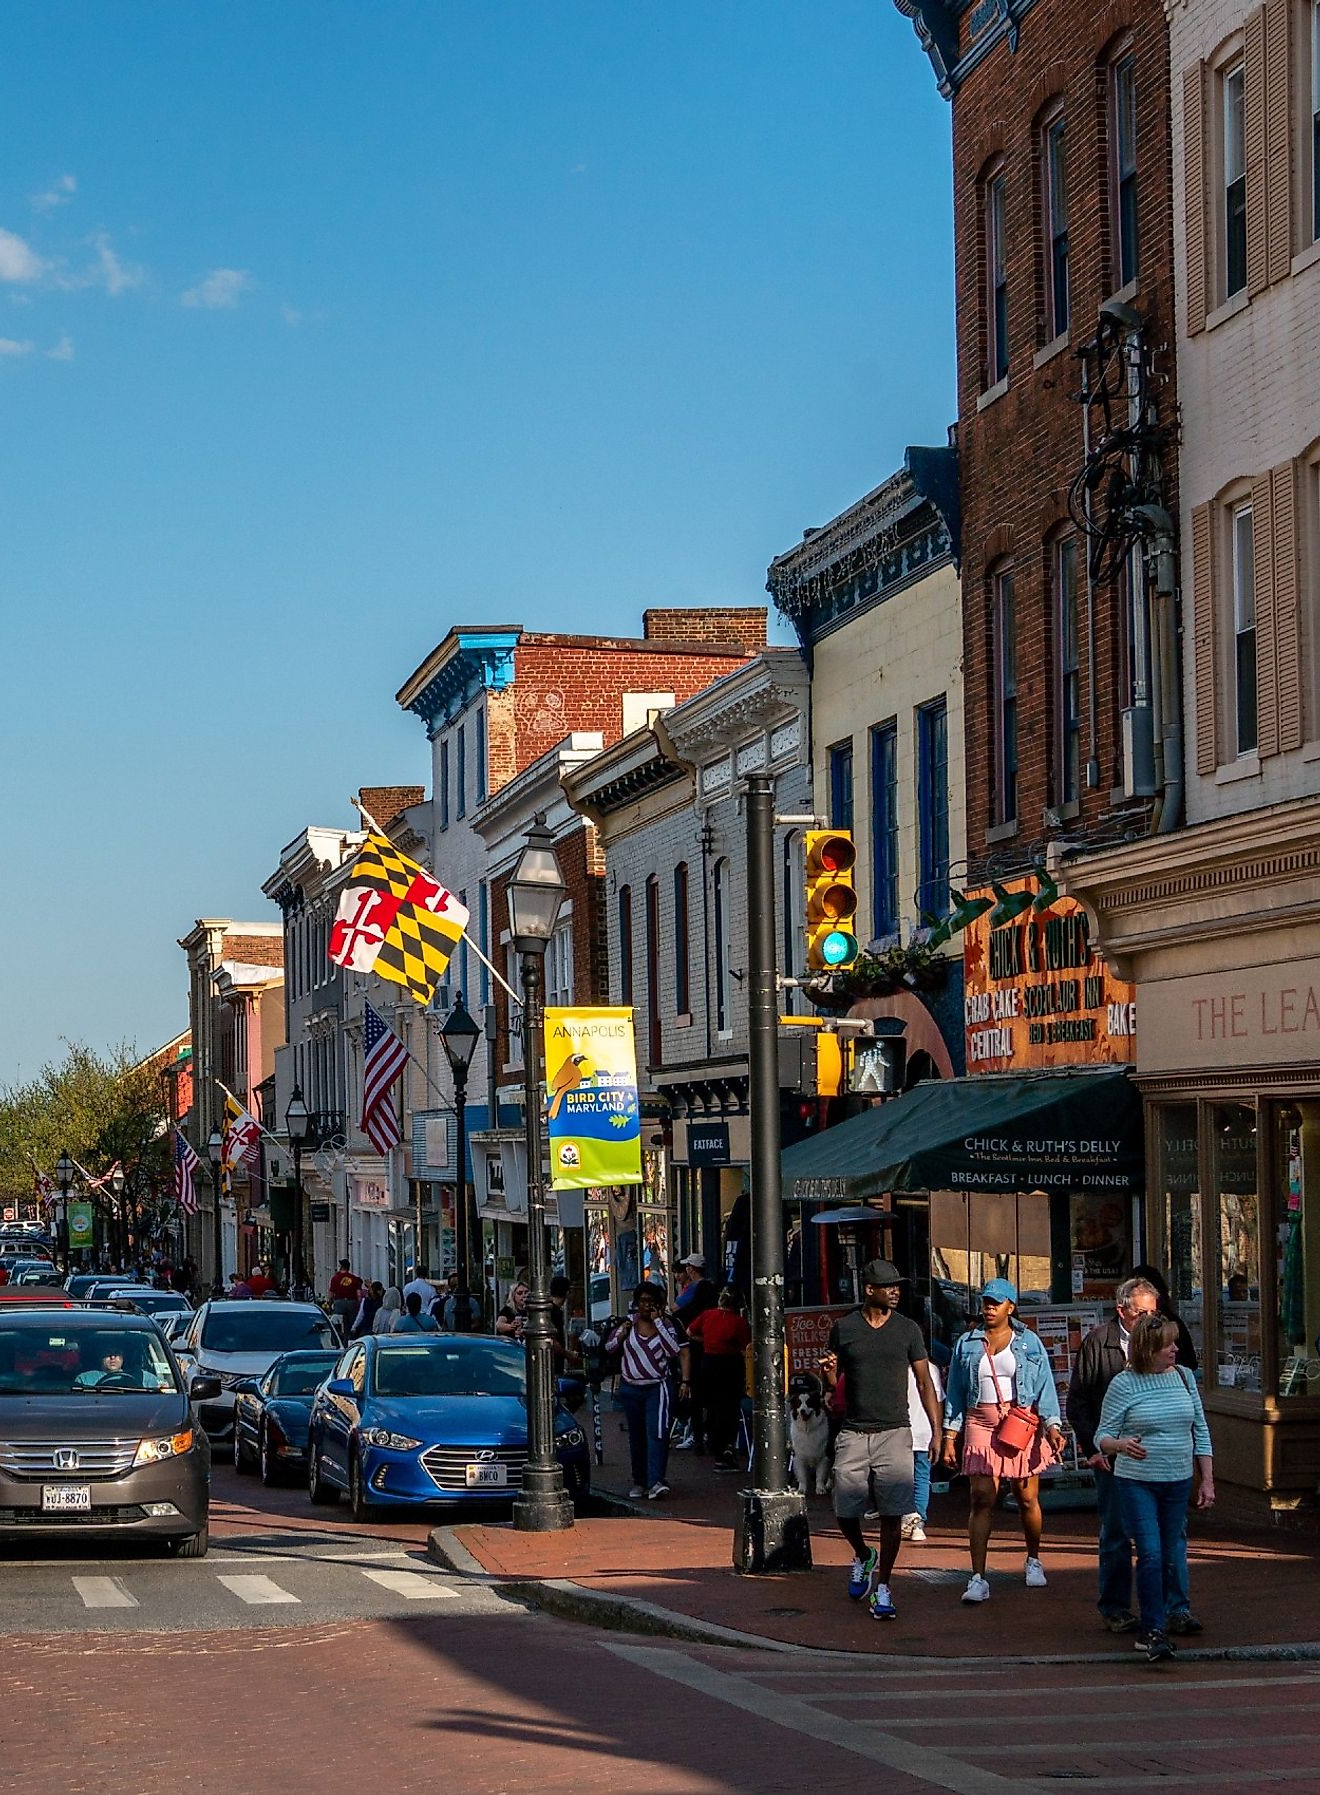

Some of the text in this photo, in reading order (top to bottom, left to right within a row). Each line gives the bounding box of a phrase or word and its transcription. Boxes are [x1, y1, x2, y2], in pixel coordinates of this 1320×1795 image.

[989, 925, 1022, 981] CHICK
[965, 987, 1019, 1026] CRAB CAKE
[1192, 995, 1248, 1040] THE
[553, 1025, 625, 1038] ANNAPOLIS
[970, 1027, 1013, 1062] CENTRAL
[567, 1091, 625, 1104] BIRD CITY
[567, 1102, 625, 1113] MARYLAND
[693, 1138, 724, 1150] FATFACE
[964, 1137, 1121, 1153] CHICK & RUTH'S DELLY
[1044, 1154, 1060, 1163] Bed
[951, 1172, 1129, 1186] BREAKFAST LUNCH DINNER
